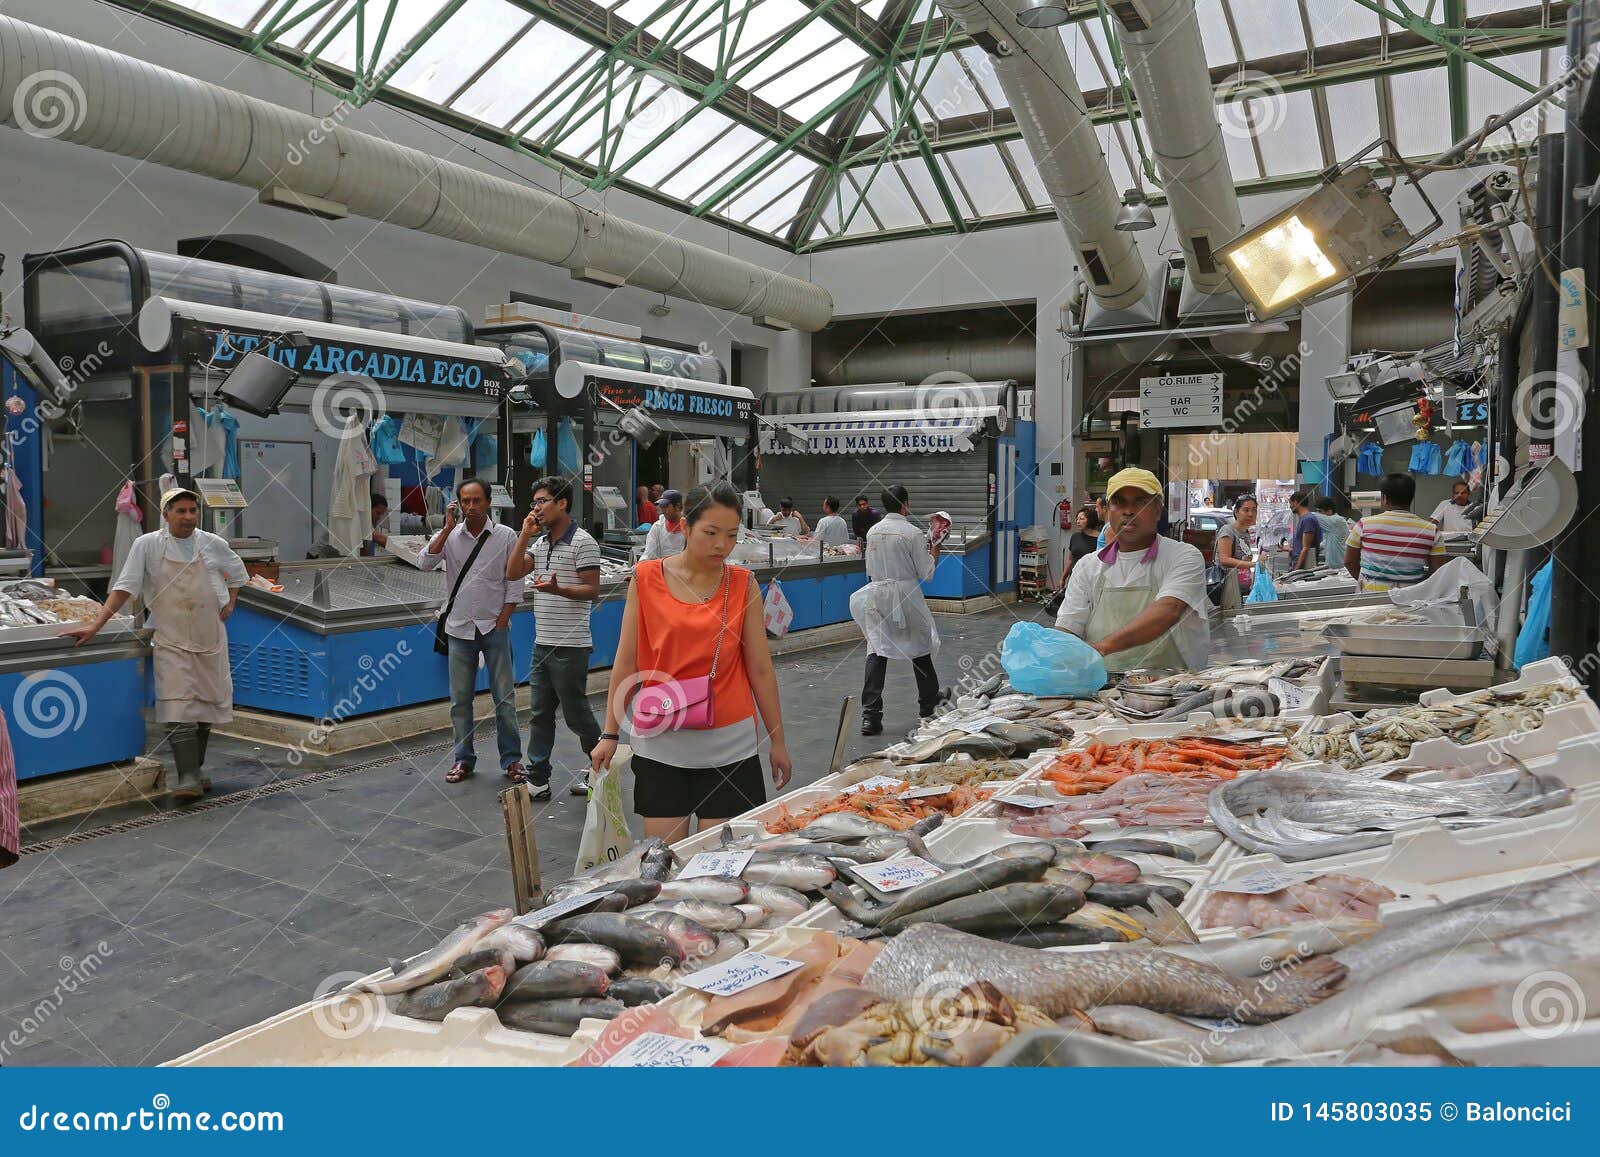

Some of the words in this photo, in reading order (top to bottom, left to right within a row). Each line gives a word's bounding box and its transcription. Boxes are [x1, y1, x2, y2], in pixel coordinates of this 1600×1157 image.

[303, 344, 427, 383] ARCADIA
[432, 360, 482, 389] EGO
[484, 379, 500, 389] BOX
[1159, 376, 1203, 386] CO.RI.ME
[485, 388, 499, 396] 112
[644, 389, 685, 412] PESCE
[689, 395, 733, 417] FRESCO
[737, 401, 751, 411] BOX
[1170, 397, 1191, 406] BAR
[739, 411, 749, 420] 92
[1173, 407, 1188, 416] WC
[825, 437, 839, 449] DI
[846, 436, 886, 449] MARE
[892, 434, 954, 448] FRESCHI
